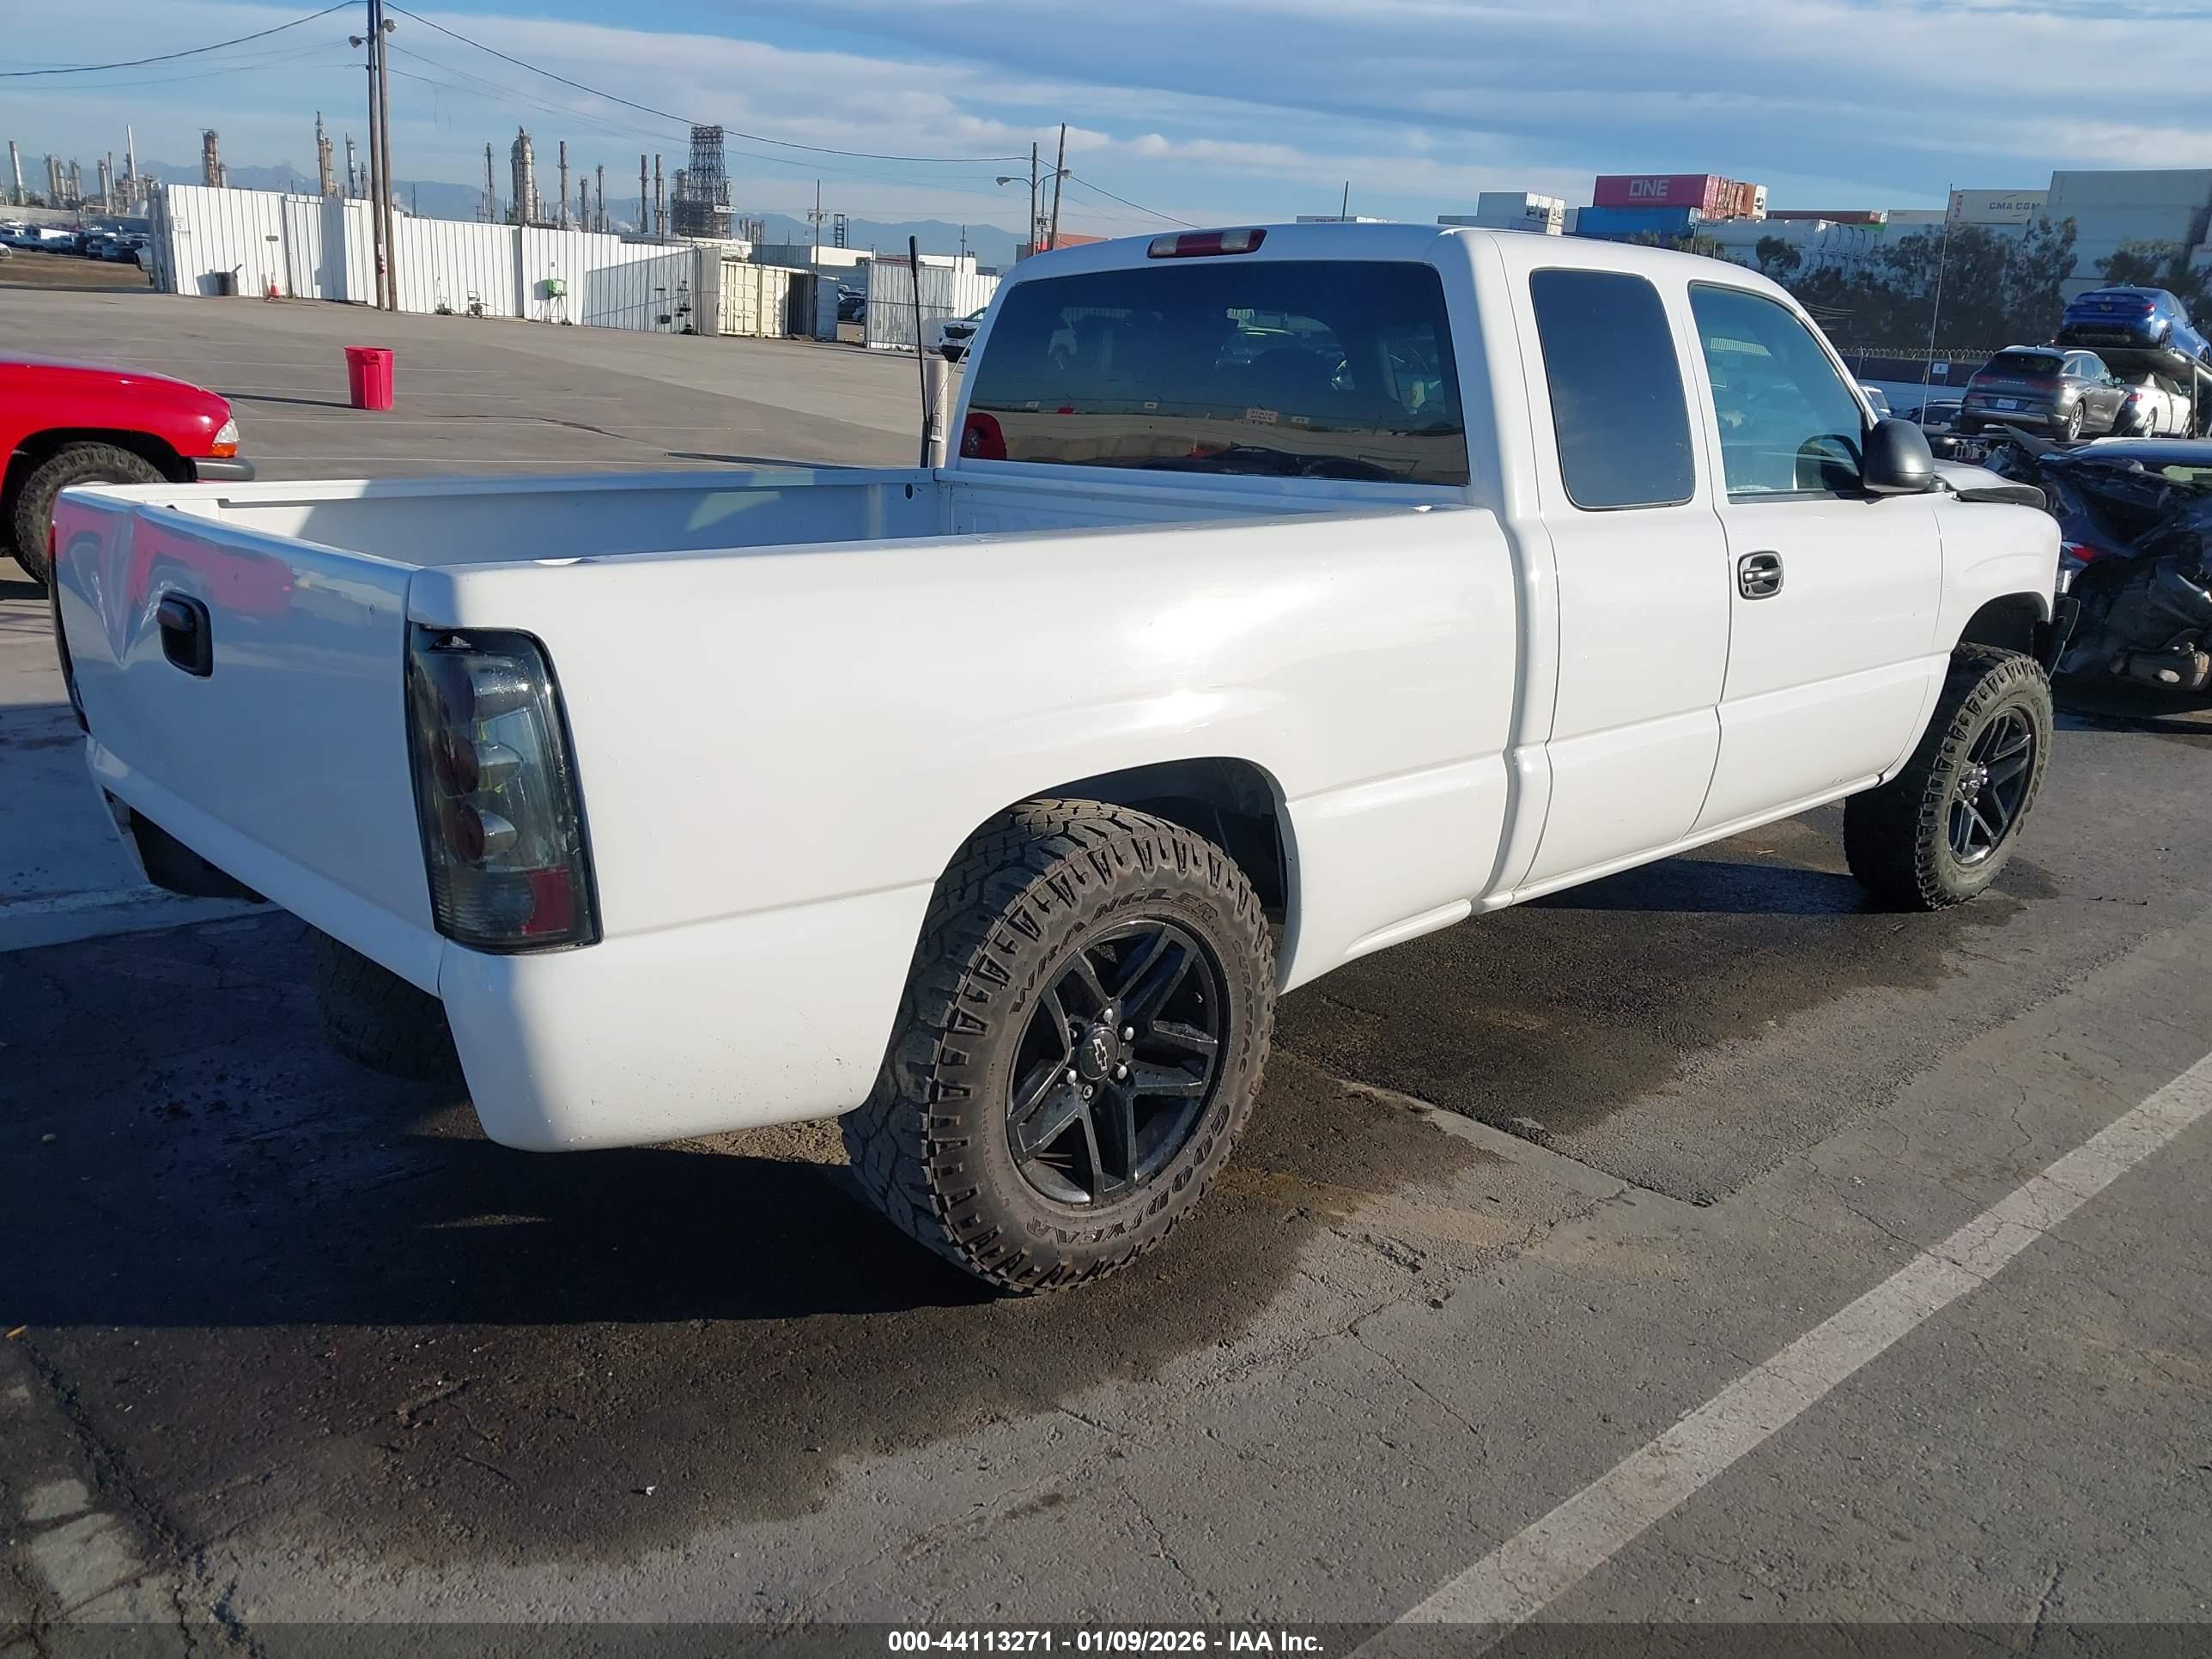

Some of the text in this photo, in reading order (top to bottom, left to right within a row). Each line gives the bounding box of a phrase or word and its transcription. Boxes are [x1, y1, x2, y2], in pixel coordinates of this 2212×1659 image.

[1628, 179, 1670, 197] ONE
[1989, 202, 2013, 210] CMA
[1009, 888, 1219, 1015] WRANGLER
[1231, 939, 1254, 1073] DURATRAC
[1025, 1103, 1230, 1244] GOODYEAR
